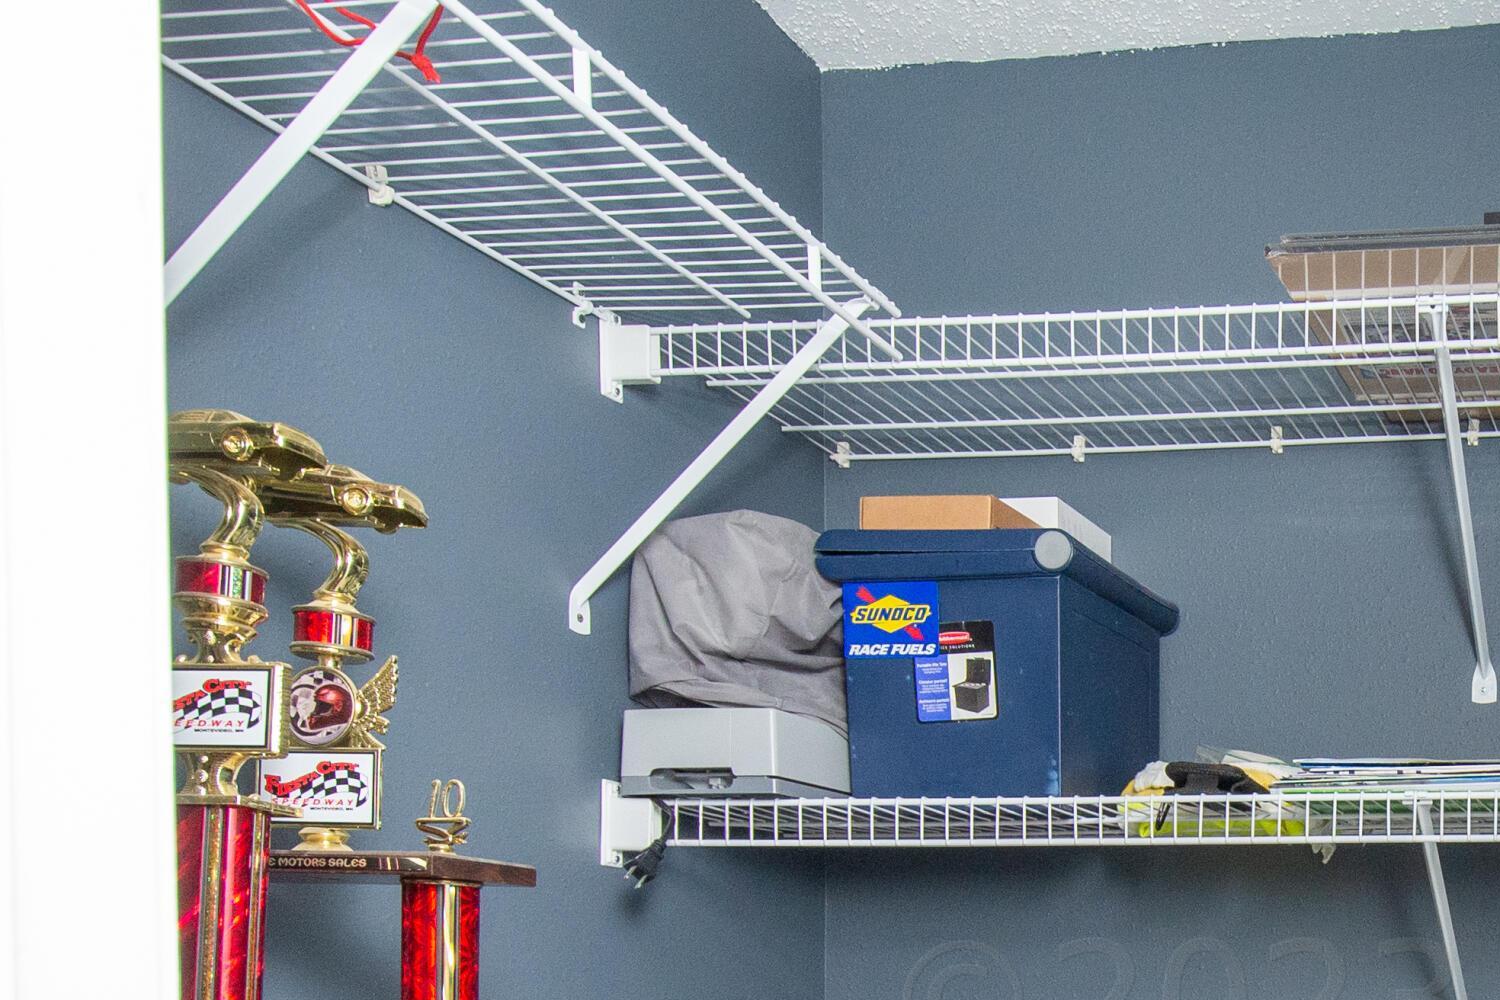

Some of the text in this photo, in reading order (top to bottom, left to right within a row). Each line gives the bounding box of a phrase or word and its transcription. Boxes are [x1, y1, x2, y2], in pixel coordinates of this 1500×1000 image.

[855, 607, 928, 622] SUNOCO
[849, 644, 936, 656] RACE FUELS
[202, 678, 253, 693] CITY
[316, 761, 359, 775] CITY
[272, 798, 354, 807] SPEEDWAY
[429, 778, 466, 818] 10
[278, 857, 327, 868] MOTORS
[328, 858, 367, 868] SALES
